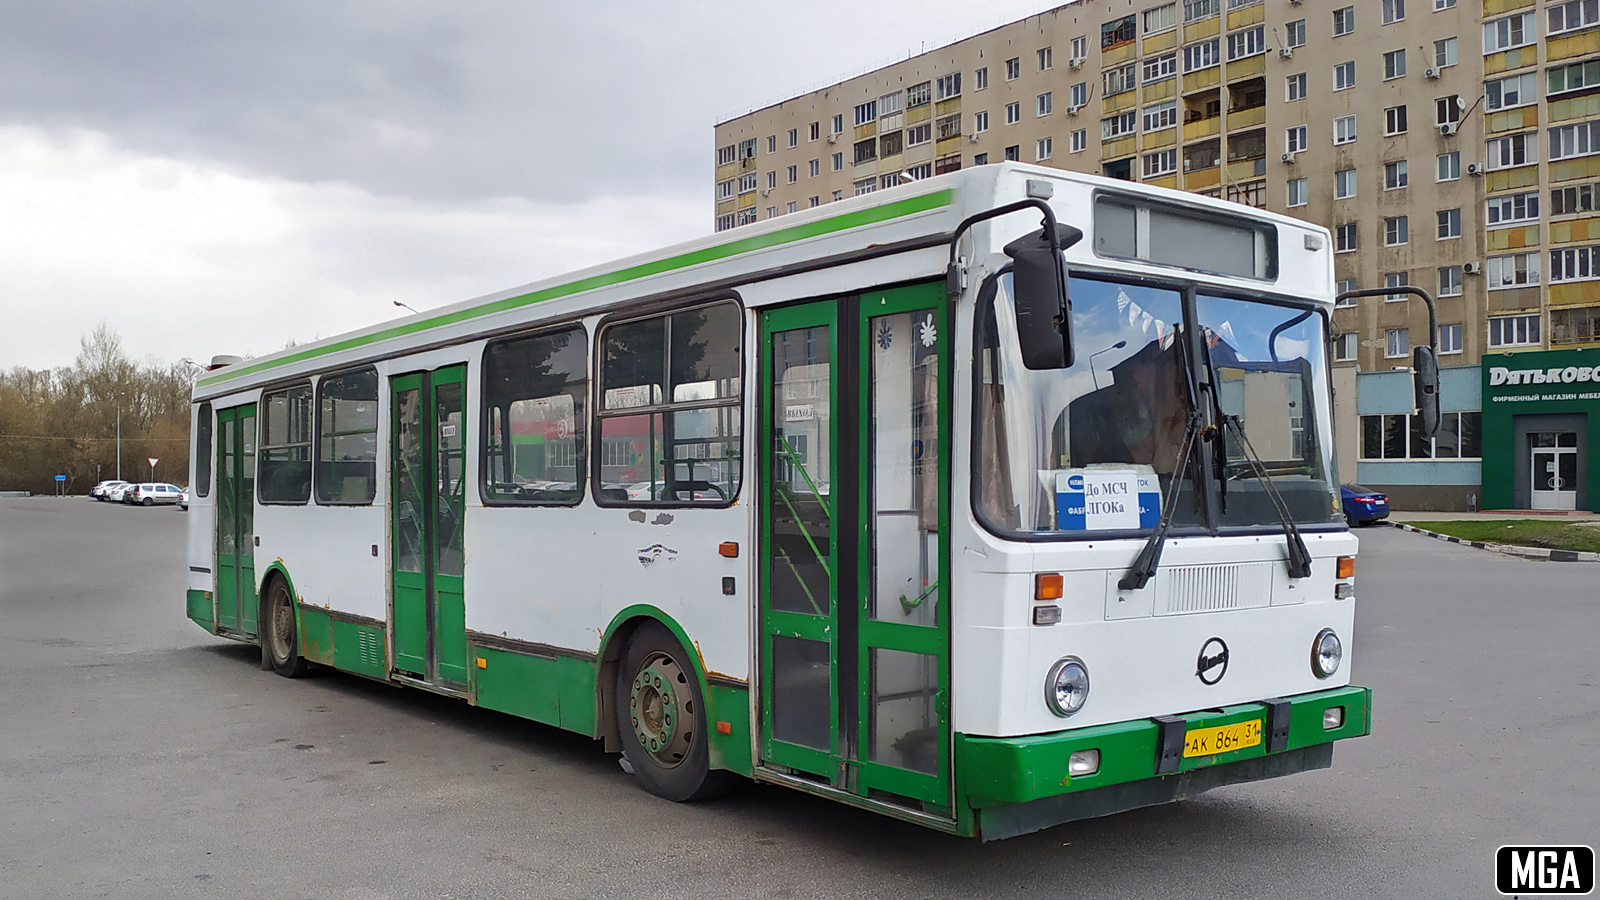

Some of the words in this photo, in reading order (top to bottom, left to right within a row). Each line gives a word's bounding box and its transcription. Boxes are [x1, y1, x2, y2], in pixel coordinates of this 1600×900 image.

[1492, 394, 1540, 402] ФИРМЕННЫЙ
[1541, 393, 1577, 401] МАГАЗИН
[1086, 483, 1099, 497] До
[1102, 482, 1128, 495] МСЧ
[1086, 501, 1125, 515] ЛГОКа
[1191, 736, 1208, 753] АК
[1216, 728, 1239, 750] 864
[1245, 722, 1257, 738] 31
